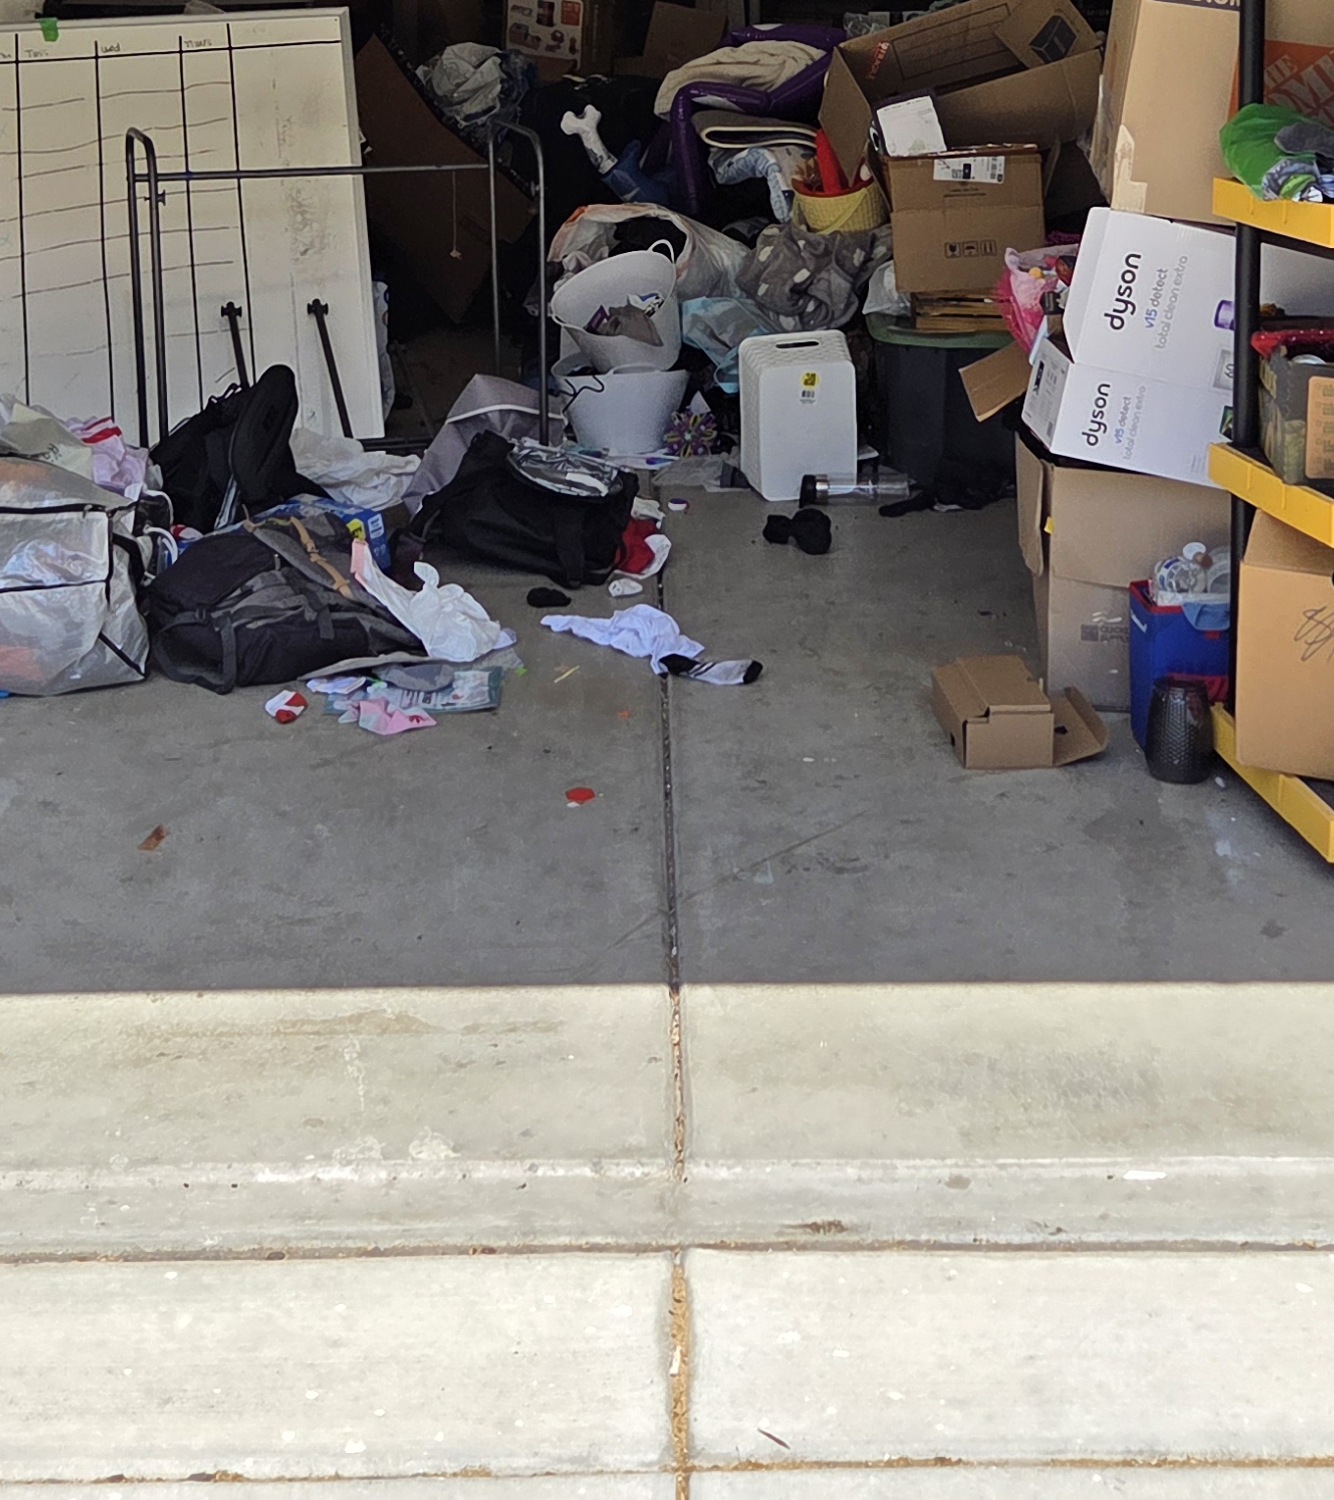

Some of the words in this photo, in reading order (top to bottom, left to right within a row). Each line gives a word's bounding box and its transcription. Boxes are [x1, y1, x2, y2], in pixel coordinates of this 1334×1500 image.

[1104, 252, 1142, 331] dyson
[1149, 267, 1169, 306] detect
[1155, 318, 1171, 349] total
[1163, 284, 1180, 319] clean
[1174, 255, 1188, 285] extra
[1144, 308, 1158, 329] v15
[1081, 382, 1111, 447] dyson
[1115, 427, 1125, 444] v15
[1118, 395, 1132, 427] detect
[1123, 435, 1135, 461] total
[1129, 409, 1141, 436] clean
[1138, 385, 1147, 409] extra
